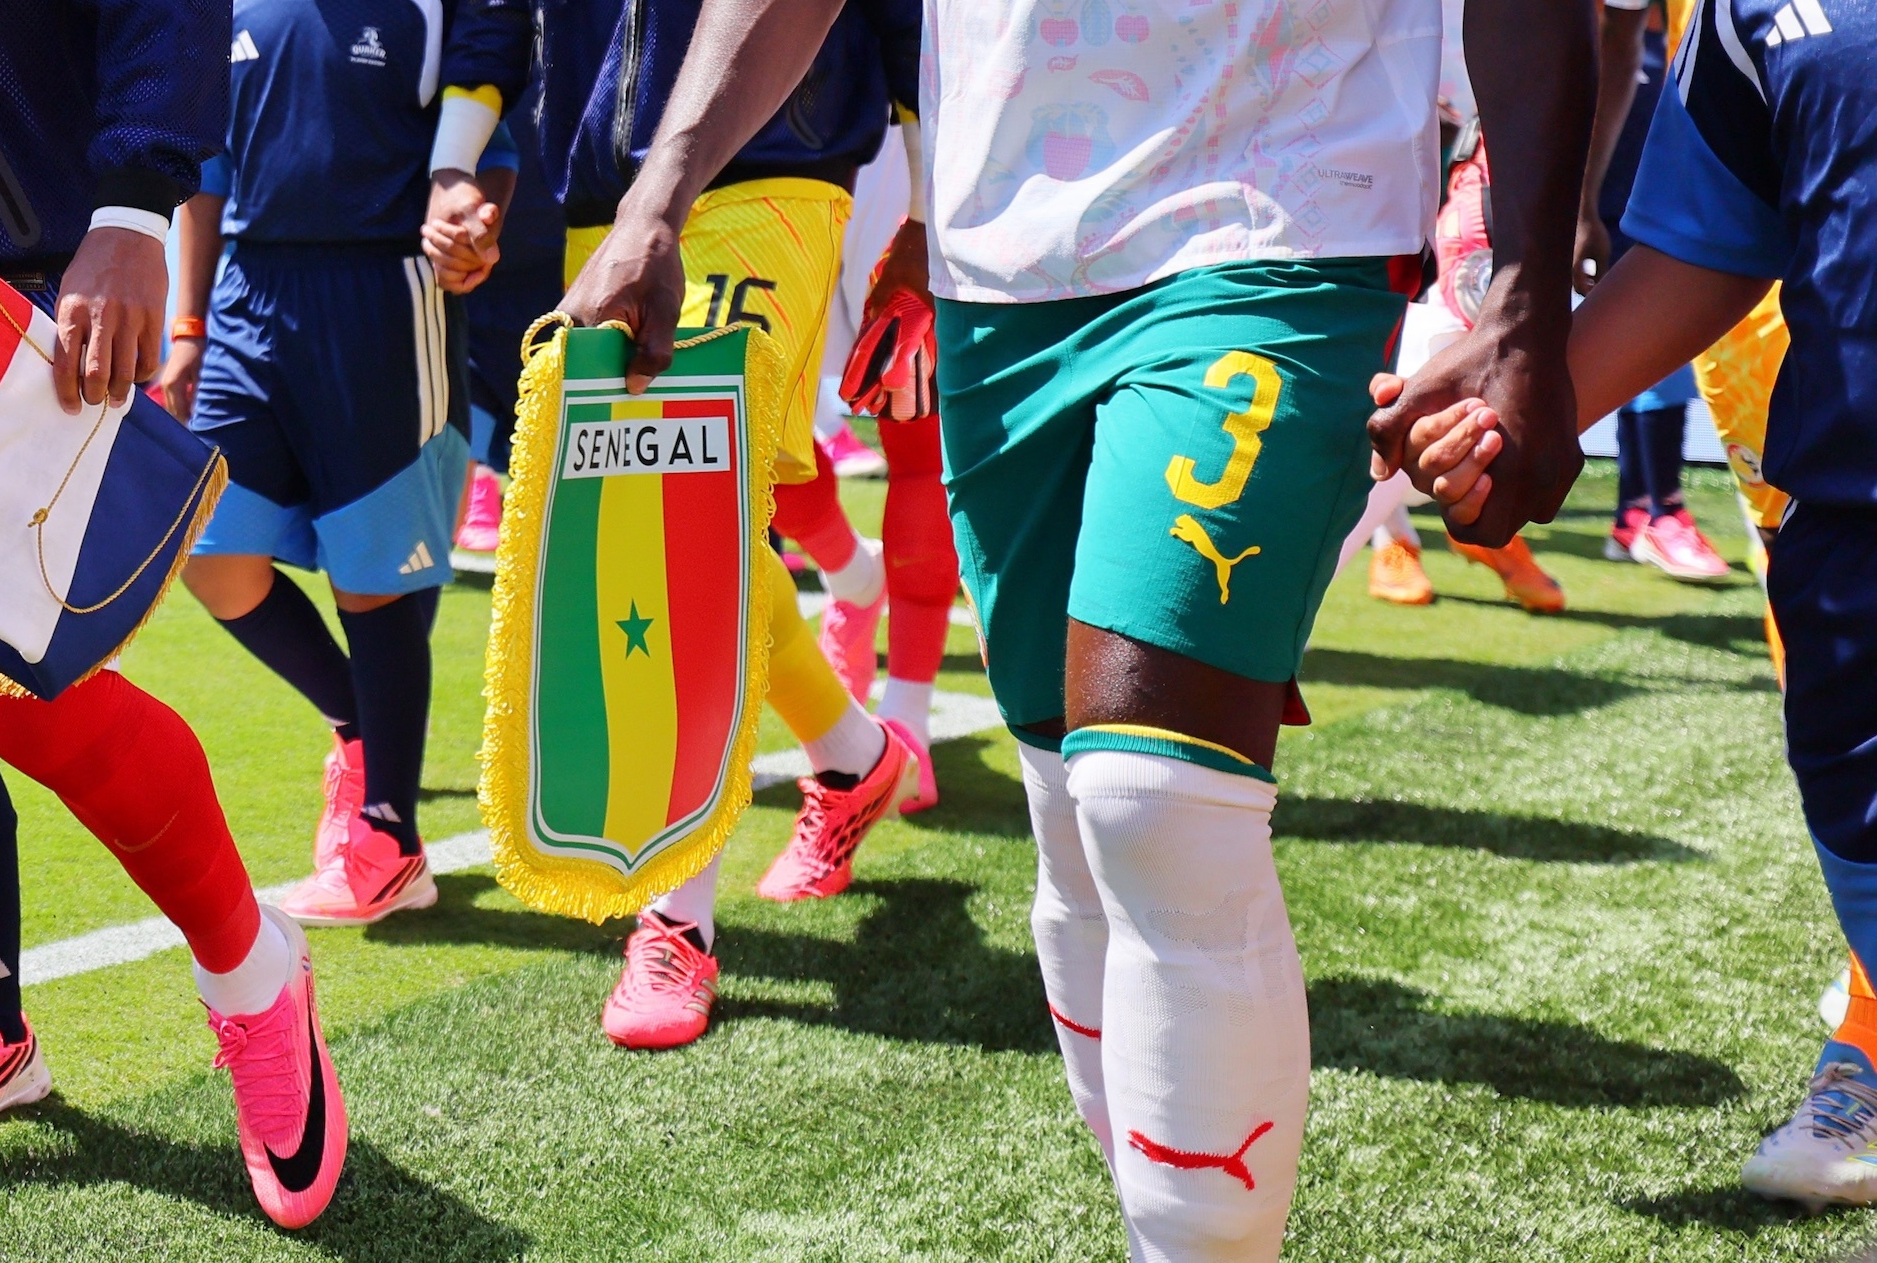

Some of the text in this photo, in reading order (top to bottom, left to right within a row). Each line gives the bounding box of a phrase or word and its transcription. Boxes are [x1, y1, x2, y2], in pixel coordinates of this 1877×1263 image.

[350, 44, 387, 59] QUAKER
[1317, 168, 1374, 184] ULTRAWEAVE
[1164, 349, 1283, 510] 3
[573, 425, 718, 472] SENEGAL
